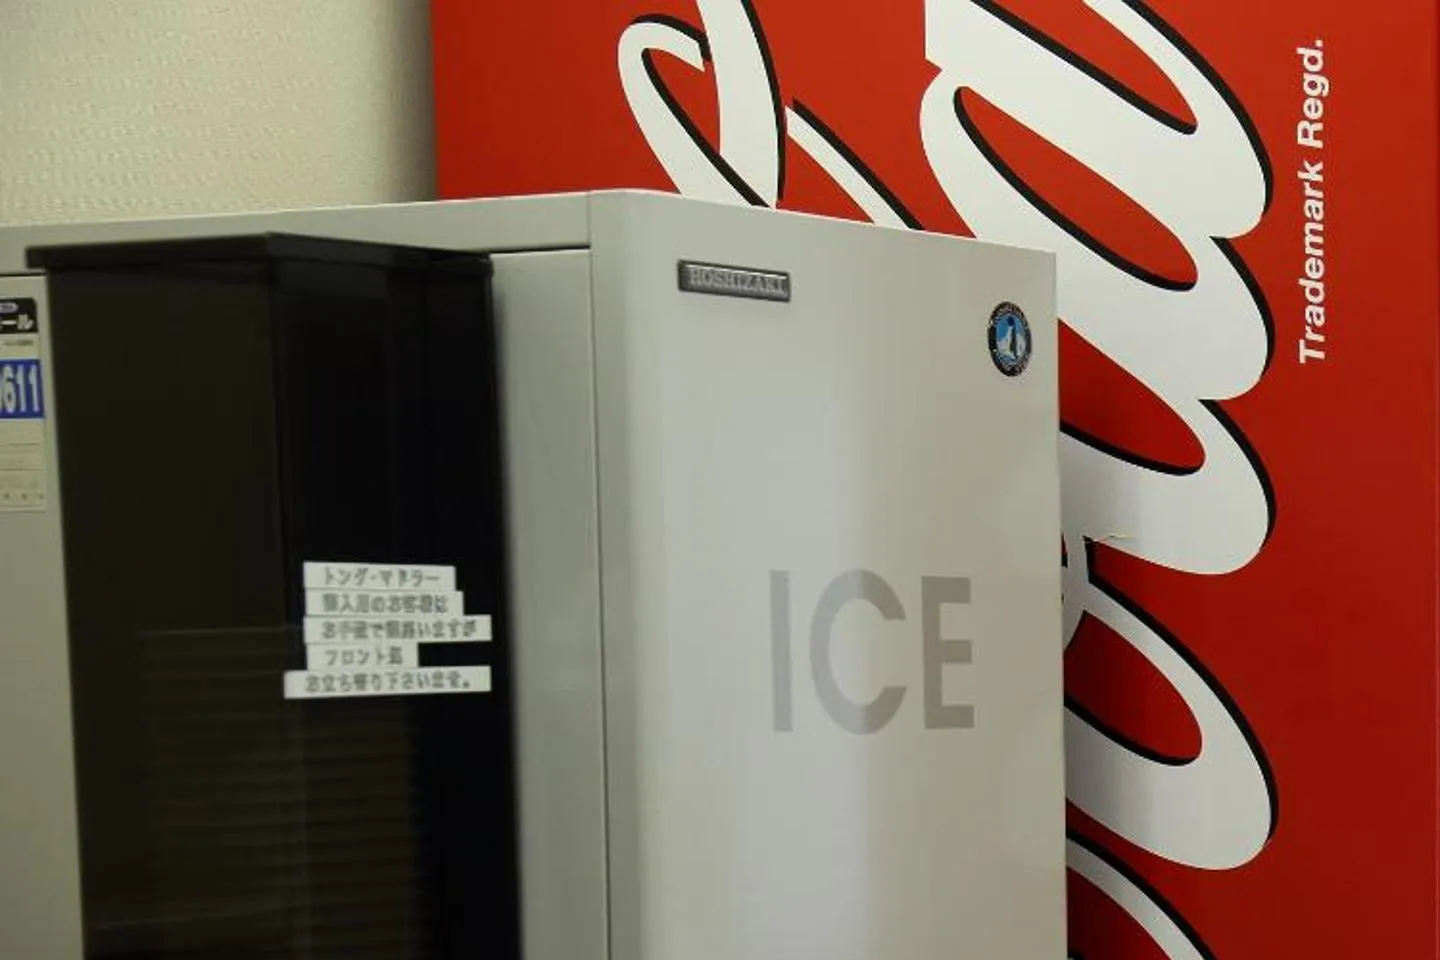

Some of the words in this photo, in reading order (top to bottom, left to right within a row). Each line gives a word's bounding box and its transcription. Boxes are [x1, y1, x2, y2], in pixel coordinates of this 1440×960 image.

[1297, 38, 1330, 149] Regd.
[689, 266, 789, 298] HOSHIZAKI
[1298, 159, 1326, 364] Trademark
[770, 567, 976, 736] ICE
